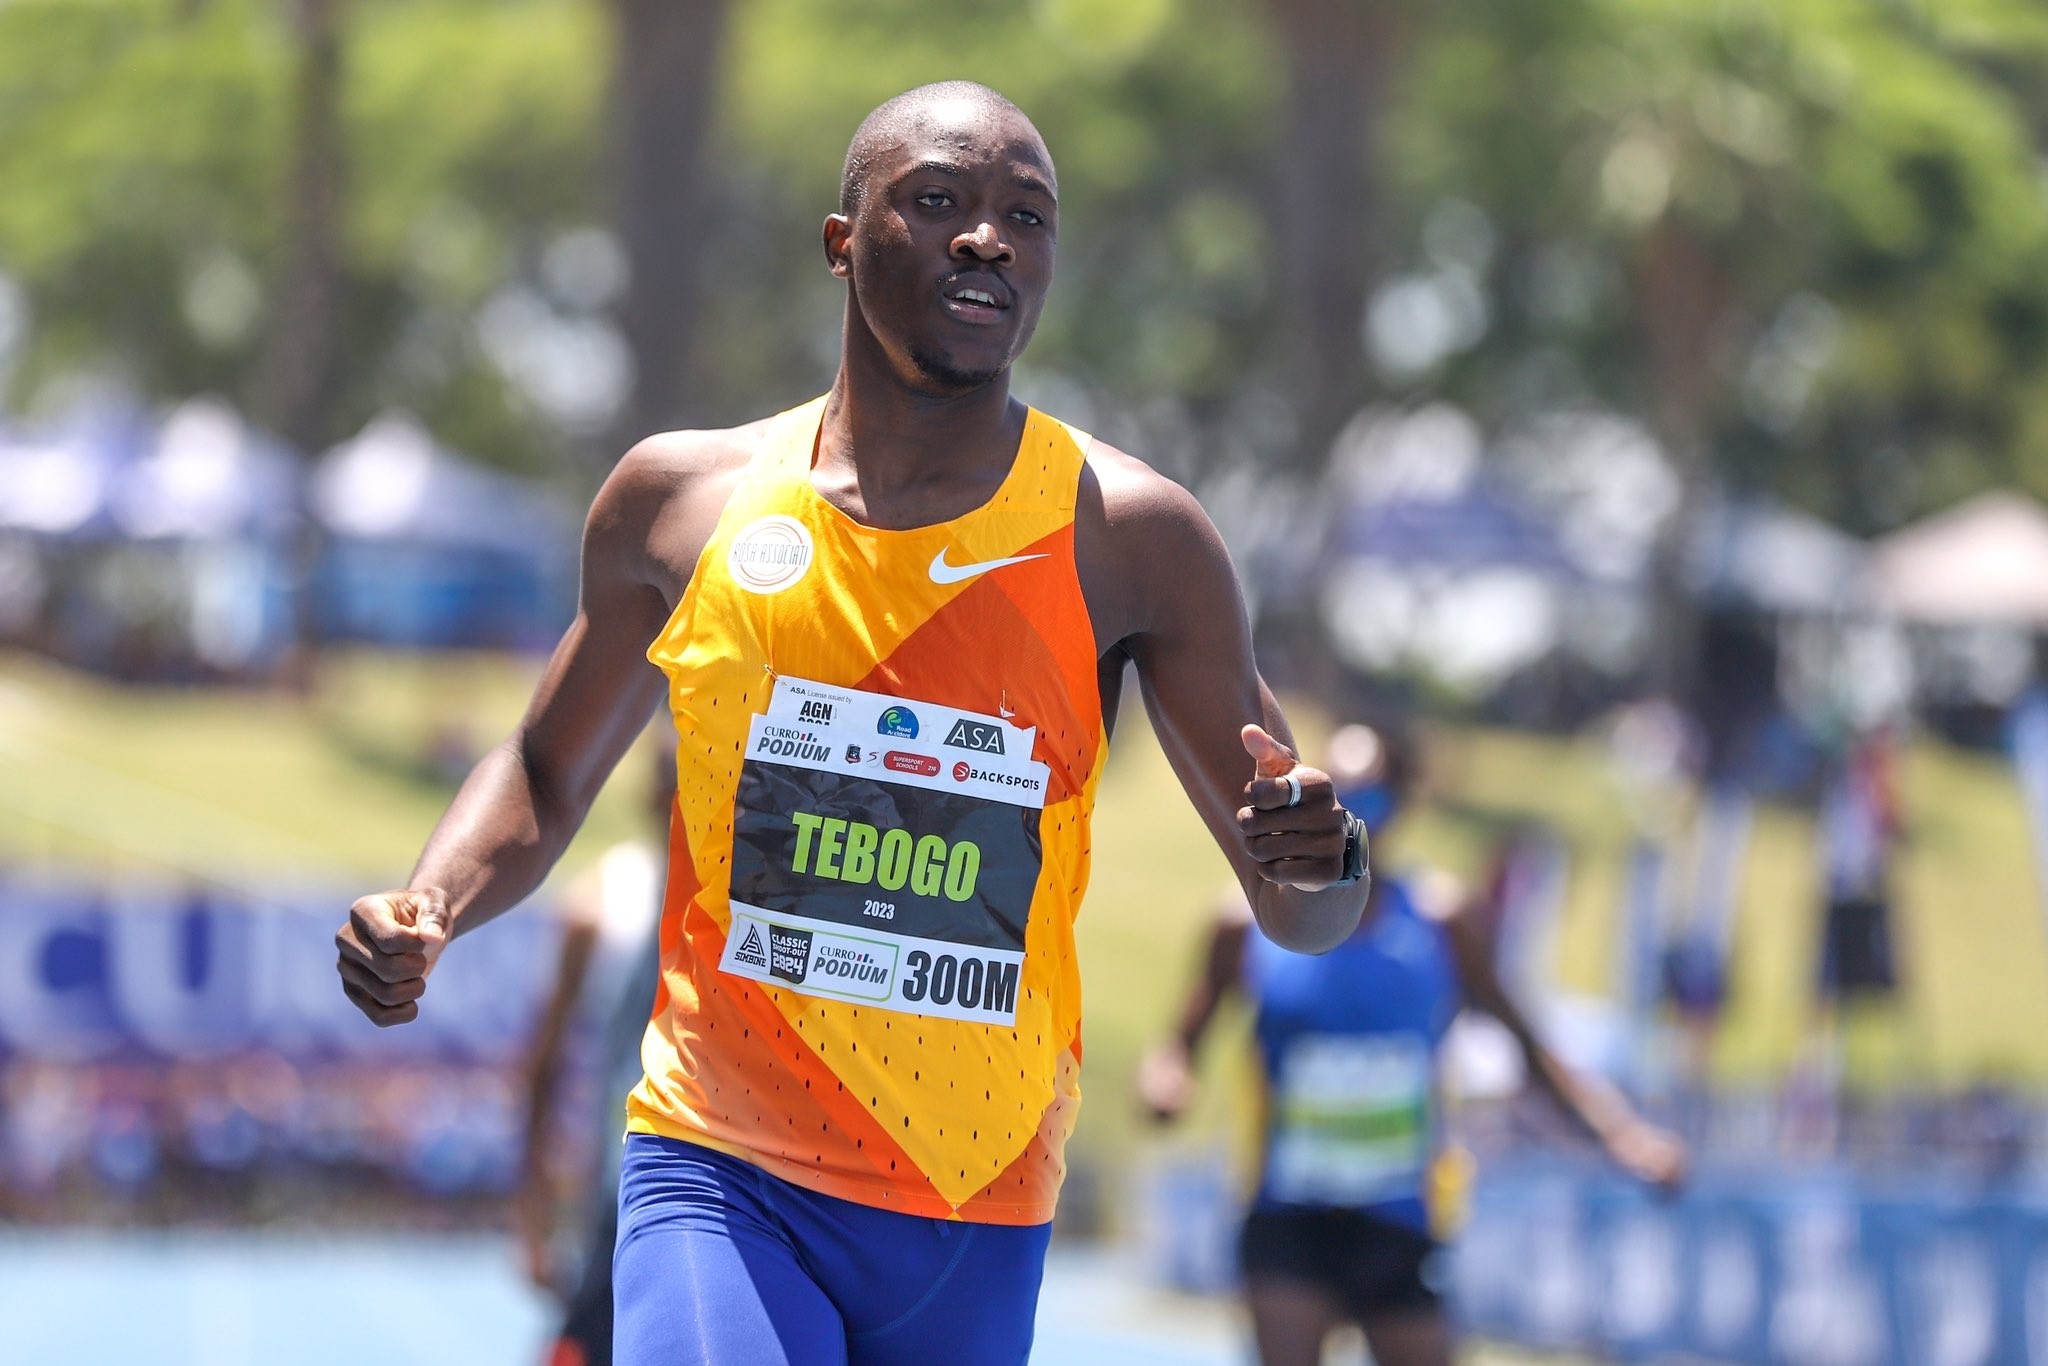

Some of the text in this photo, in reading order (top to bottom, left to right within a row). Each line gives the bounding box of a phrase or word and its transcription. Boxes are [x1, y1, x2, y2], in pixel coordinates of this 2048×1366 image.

[732, 542, 808, 566] ROSA ASSOCIATI
[790, 686, 852, 704] ASA License issued by
[800, 700, 833, 720] AGN
[764, 725, 800, 740] CURRO
[896, 725, 912, 733] Road
[950, 724, 1001, 753] ASA
[757, 736, 832, 762] PODIUM
[893, 755, 924, 766] SUPERSPORT
[895, 762, 919, 771] SCHOOLS
[970, 769, 1040, 790] BACKSPOTS
[791, 811, 981, 902] TEBOGO
[863, 899, 896, 920] 2023
[771, 933, 809, 949] CLASSIC
[772, 943, 807, 957] SHOOT-OUT
[734, 951, 767, 968] SIMBINE
[820, 945, 858, 961] CURRO
[812, 956, 889, 985] PODIUM
[902, 950, 1019, 1014] 300M
